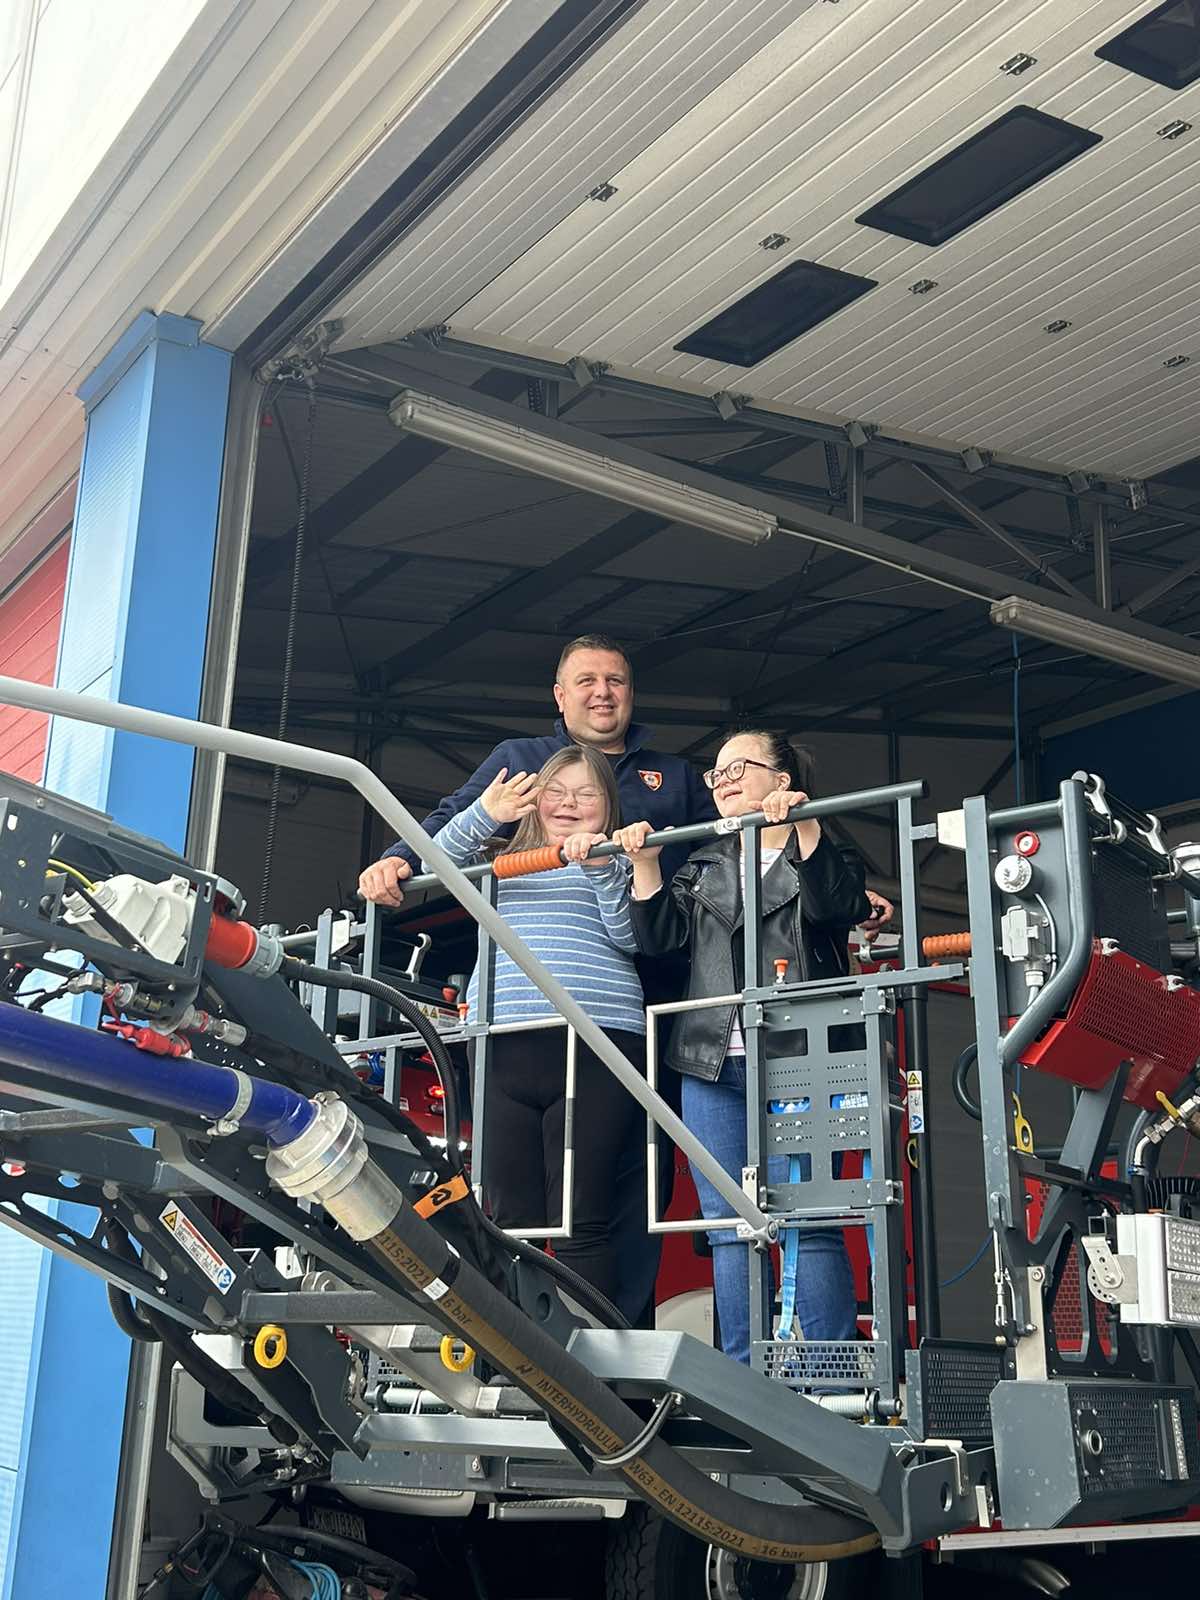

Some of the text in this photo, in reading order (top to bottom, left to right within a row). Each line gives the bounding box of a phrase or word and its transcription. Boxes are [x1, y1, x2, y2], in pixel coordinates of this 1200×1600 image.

[452, 1306, 472, 1324] bar
[536, 1379, 623, 1454] INTERHYDRAULIK
[658, 1489, 677, 1505] EN
[674, 1503, 745, 1545] 12115:2021
[761, 1545, 778, 1556] 16
[781, 1548, 805, 1558] bar
